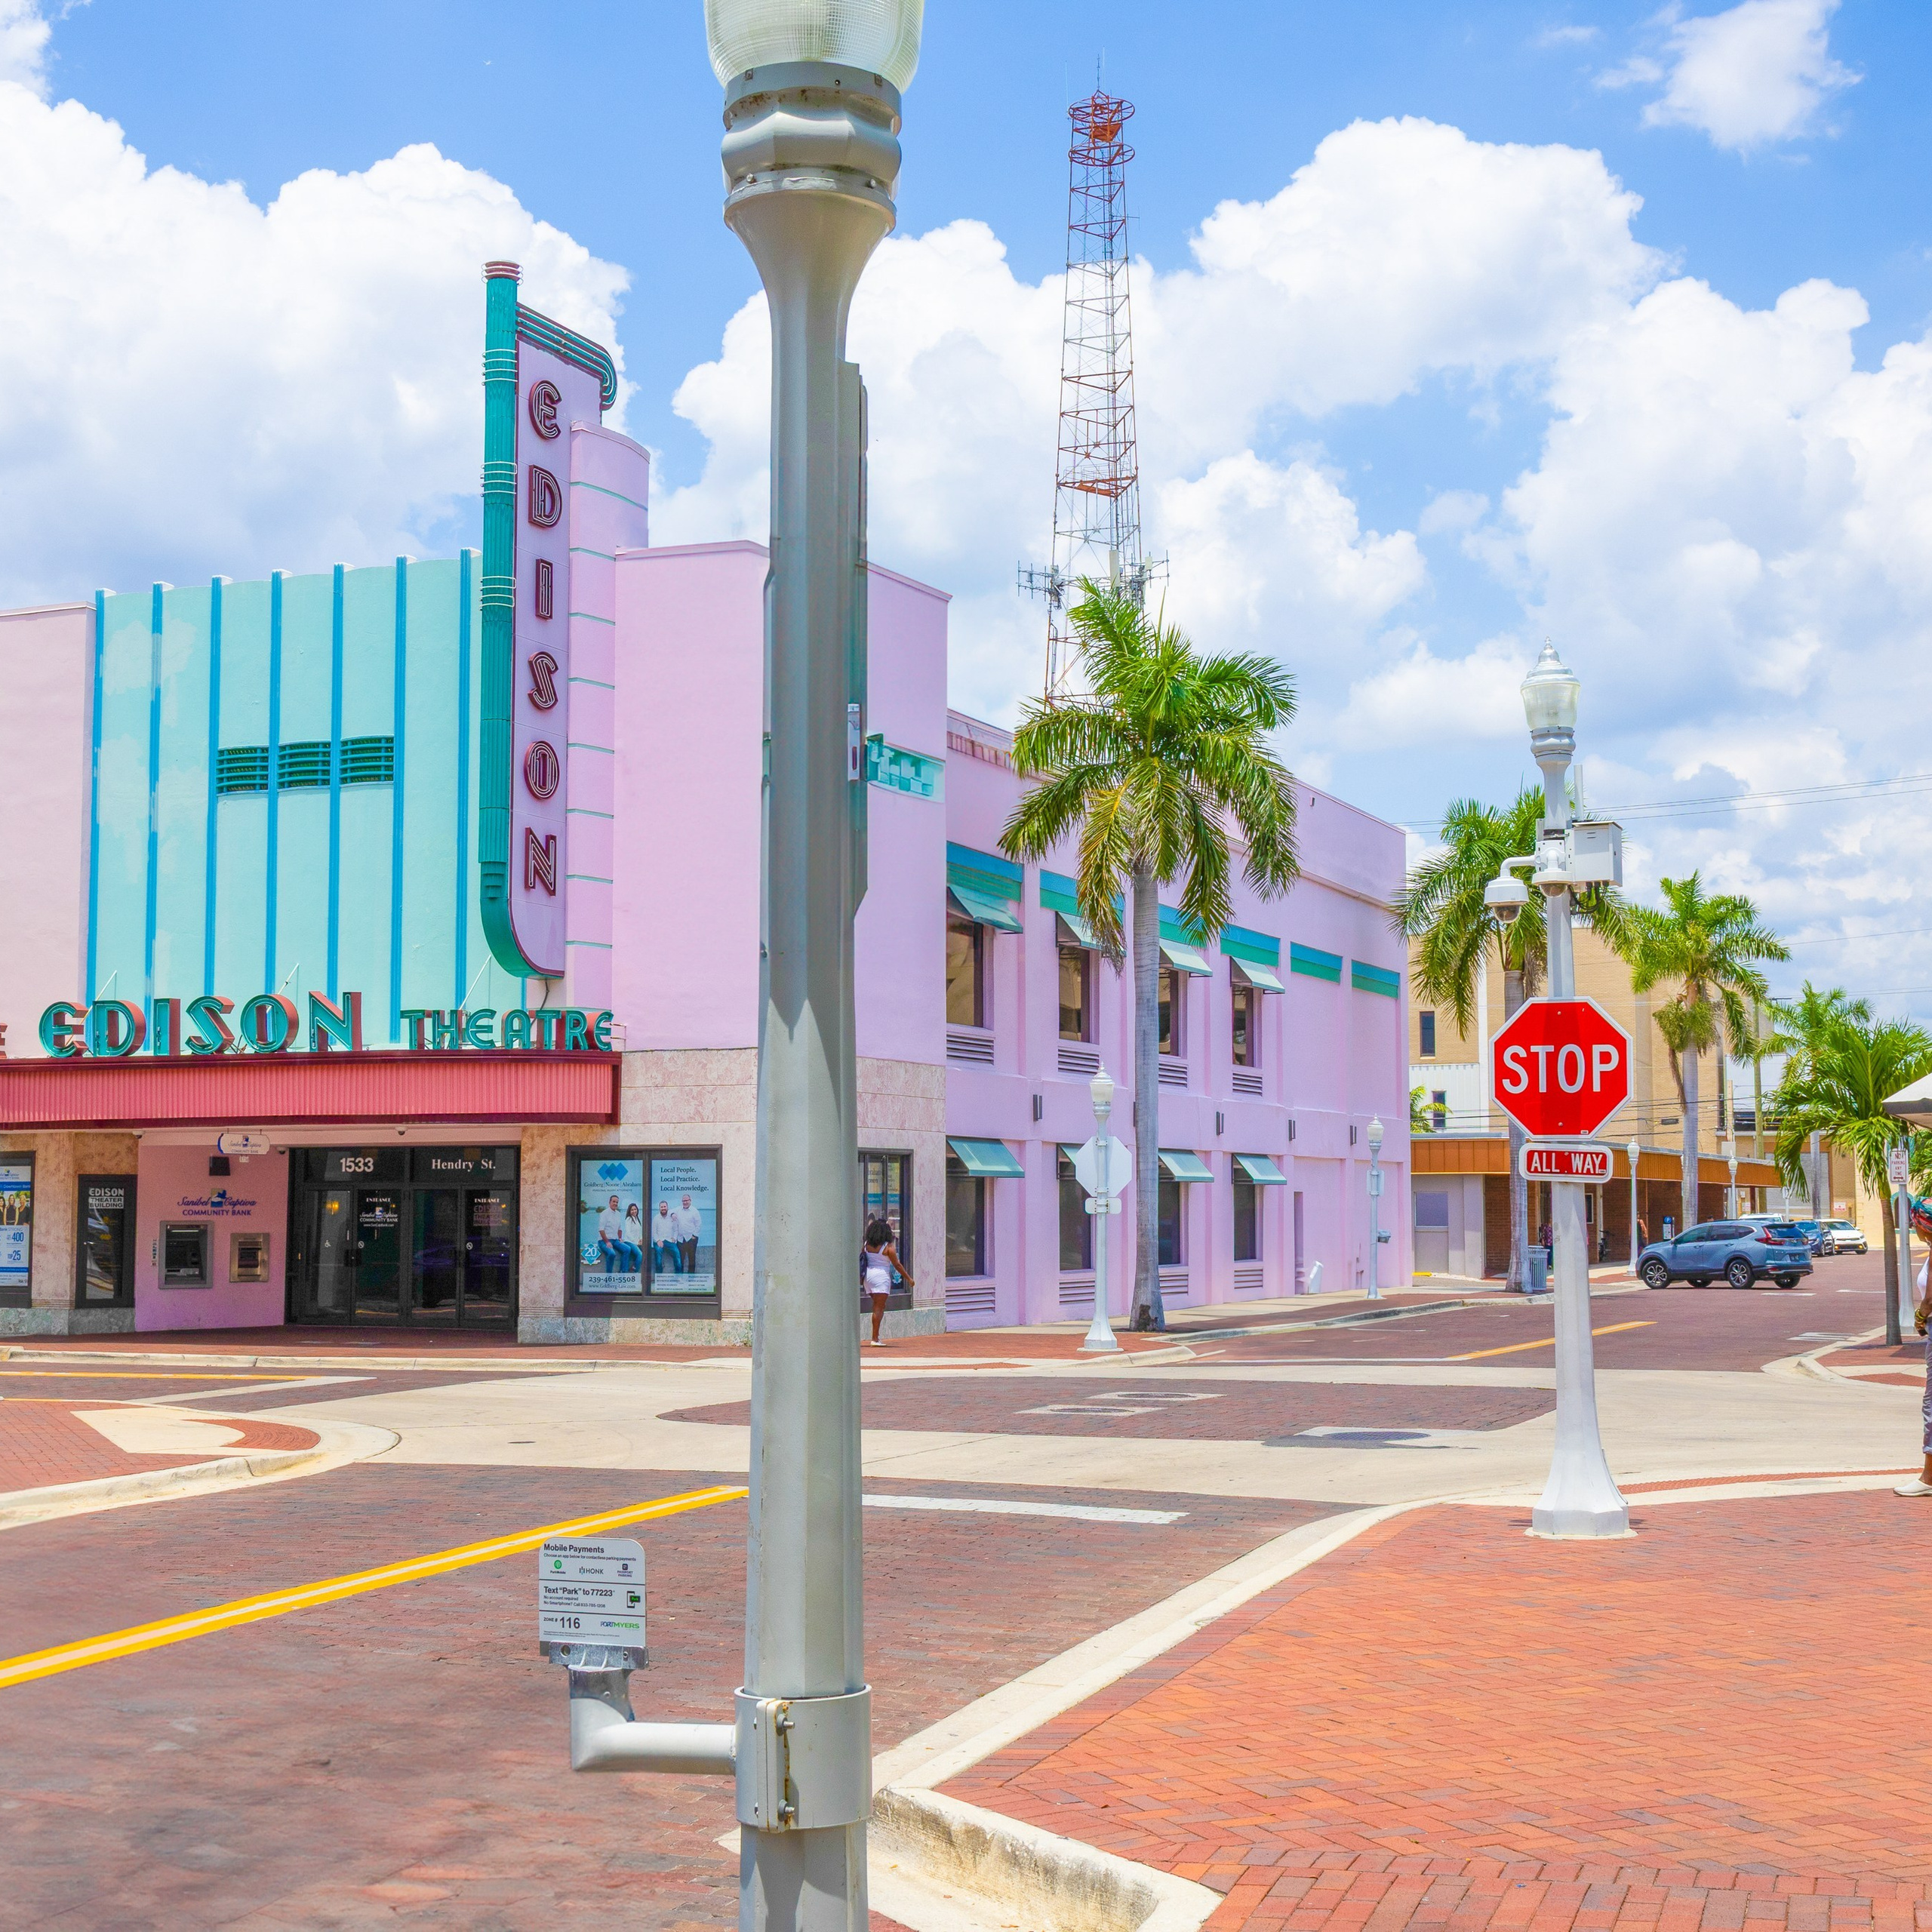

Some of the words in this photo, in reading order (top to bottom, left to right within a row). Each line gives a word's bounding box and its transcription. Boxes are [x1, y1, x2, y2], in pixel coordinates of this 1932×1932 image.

[523, 380, 563, 896] EDISON
[38, 991, 361, 1057] EDISON
[400, 1008, 614, 1052] THEATRE
[1502, 1043, 1620, 1094] STOP
[340, 1158, 374, 1172] 1533
[432, 1159, 475, 1171] Hendry
[481, 1159, 496, 1169] St.
[1531, 1152, 1560, 1173] ALL
[1571, 1153, 1603, 1174] WAY
[89, 1188, 125, 1196] EDISON
[177, 1197, 211, 1206] Sanibel
[223, 1197, 257, 1209] Captiva
[12, 1232, 24, 1241] 400
[13, 1250, 21, 1260] 25
[584, 1247, 597, 1257] 20
[543, 1543, 568, 1552] Mobile
[568, 1545, 605, 1553] Payments
[560, 1617, 580, 1629] 116
